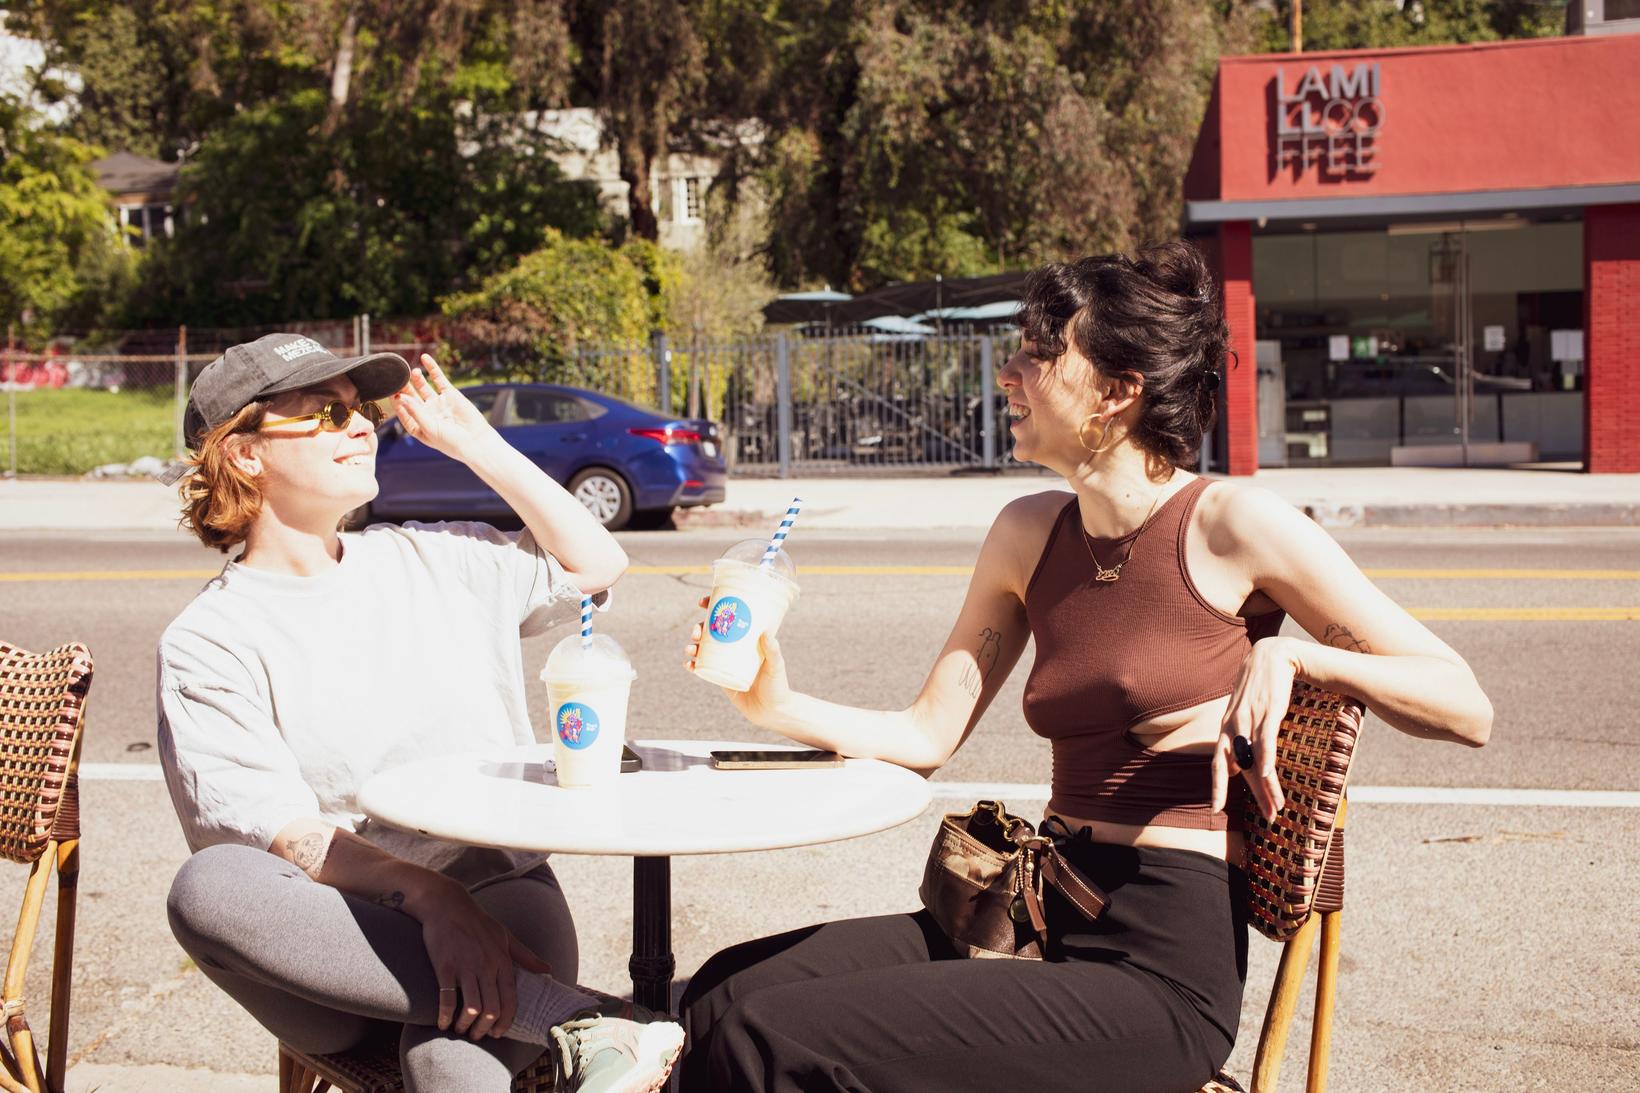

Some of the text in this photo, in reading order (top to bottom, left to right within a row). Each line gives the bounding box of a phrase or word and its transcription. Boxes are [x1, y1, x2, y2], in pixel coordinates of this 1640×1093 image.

[1277, 63, 1381, 101] LAMI
[1277, 131, 1383, 172] FFEE
[273, 338, 310, 356] MAKE
